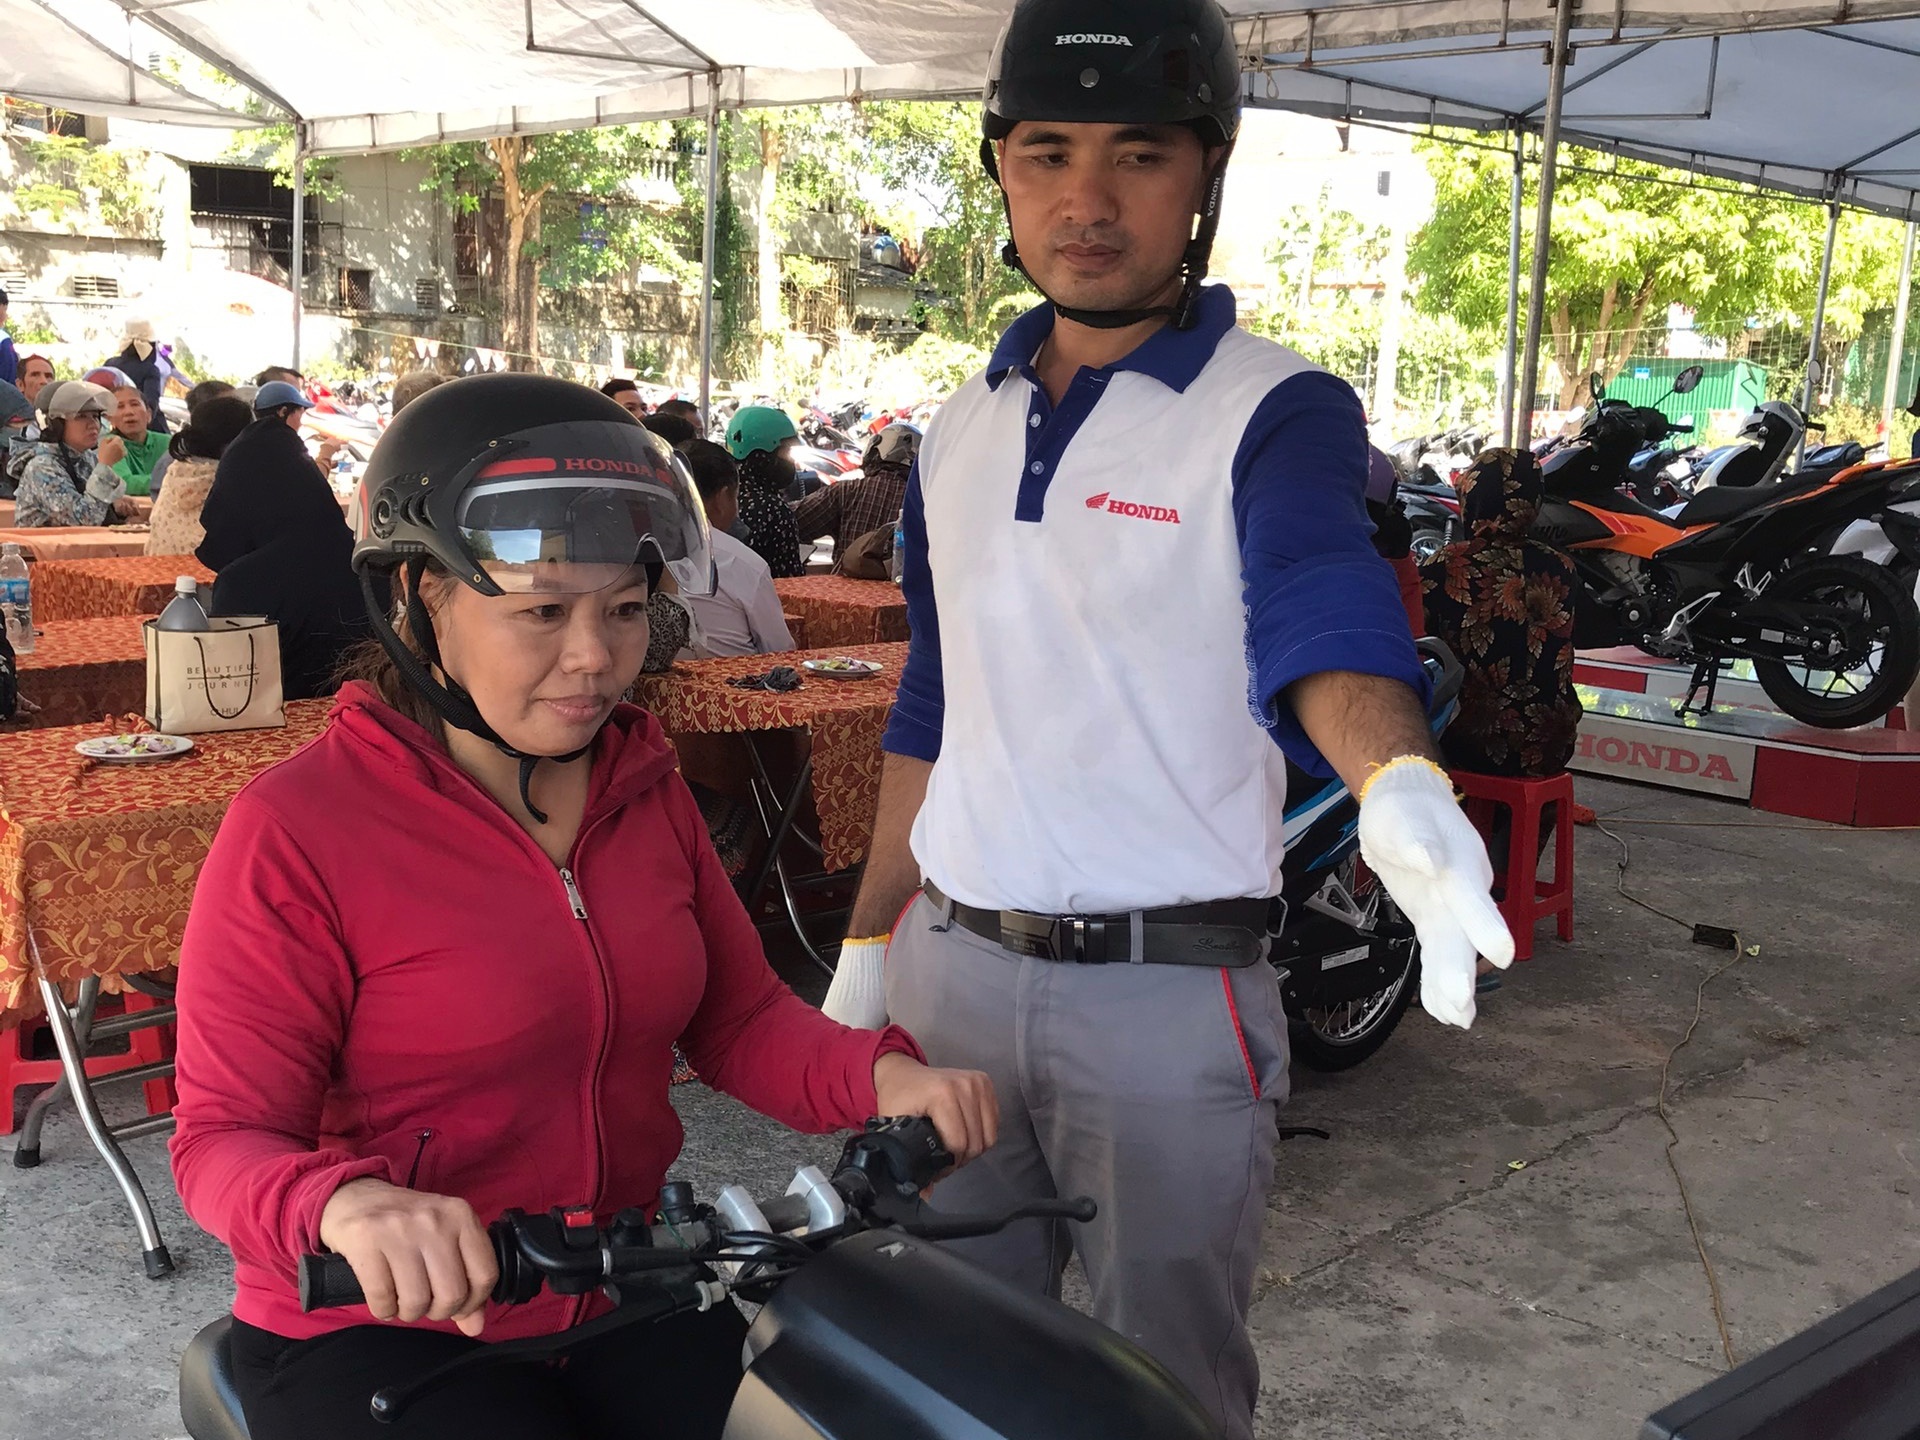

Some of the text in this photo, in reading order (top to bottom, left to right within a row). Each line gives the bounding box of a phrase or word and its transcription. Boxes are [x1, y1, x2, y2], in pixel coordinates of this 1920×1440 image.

[1055, 33, 1133, 47] HONDA
[1207, 177, 1221, 217] HONDA
[563, 457, 654, 478] HONDA
[1107, 500, 1181, 524] HONDA
[187, 678, 260, 690] JOURNEY
